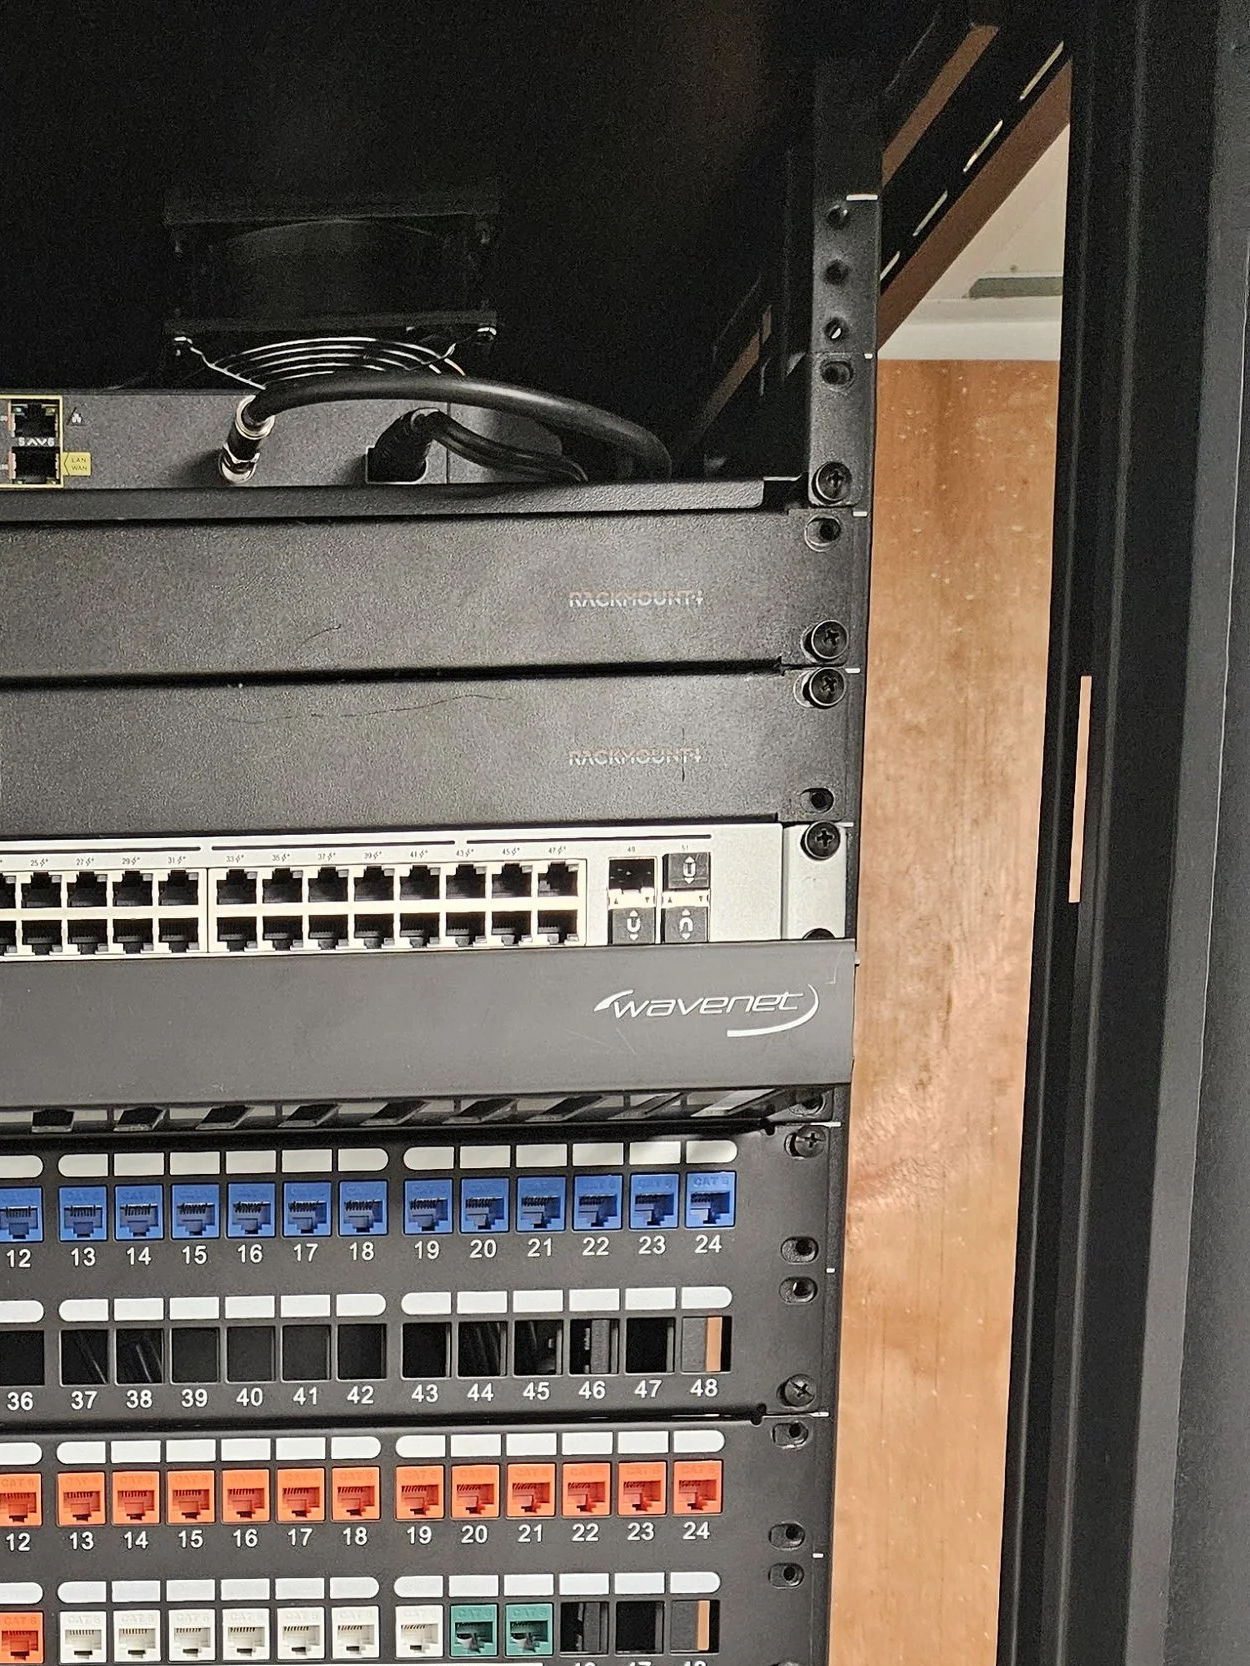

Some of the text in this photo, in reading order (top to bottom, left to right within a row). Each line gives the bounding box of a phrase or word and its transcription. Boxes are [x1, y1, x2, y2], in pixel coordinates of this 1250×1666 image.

[600, 988, 810, 1026] wavenet
[6, 1248, 31, 1268] 12
[70, 1247, 96, 1267] 13
[126, 1246, 152, 1266] 14
[182, 1245, 207, 1265] 15
[237, 1243, 263, 1264] 16
[293, 1242, 319, 1263] 17
[349, 1241, 375, 1261] 18
[414, 1240, 440, 1260] 19
[469, 1238, 497, 1259] 20
[526, 1237, 552, 1258] 21
[581, 1236, 610, 1257] 22
[638, 1234, 666, 1255] 23
[693, 1233, 723, 1254] 24
[7, 1391, 34, 1411] 36
[71, 1390, 98, 1410] 37
[126, 1389, 153, 1409] 38
[181, 1388, 208, 1408] 39
[235, 1387, 263, 1407] 40
[292, 1386, 318, 1406] 41
[346, 1385, 374, 1404] 42
[410, 1383, 439, 1403] 43
[466, 1382, 495, 1402] 44
[522, 1381, 550, 1401] 45
[577, 1380, 606, 1400] 46
[633, 1379, 663, 1399] 47
[689, 1378, 718, 1398] 48
[6, 1532, 31, 1551] 12
[69, 1531, 94, 1550] 13
[123, 1530, 149, 1549] 14
[178, 1529, 204, 1548] 15
[233, 1528, 258, 1548] 16
[287, 1527, 313, 1547] 17
[342, 1526, 368, 1546] 18
[406, 1525, 433, 1544] 19
[461, 1524, 488, 1544] 20
[517, 1523, 542, 1544] 21
[571, 1522, 599, 1542] 22
[626, 1521, 654, 1541] 23
[682, 1521, 711, 1540] 24
